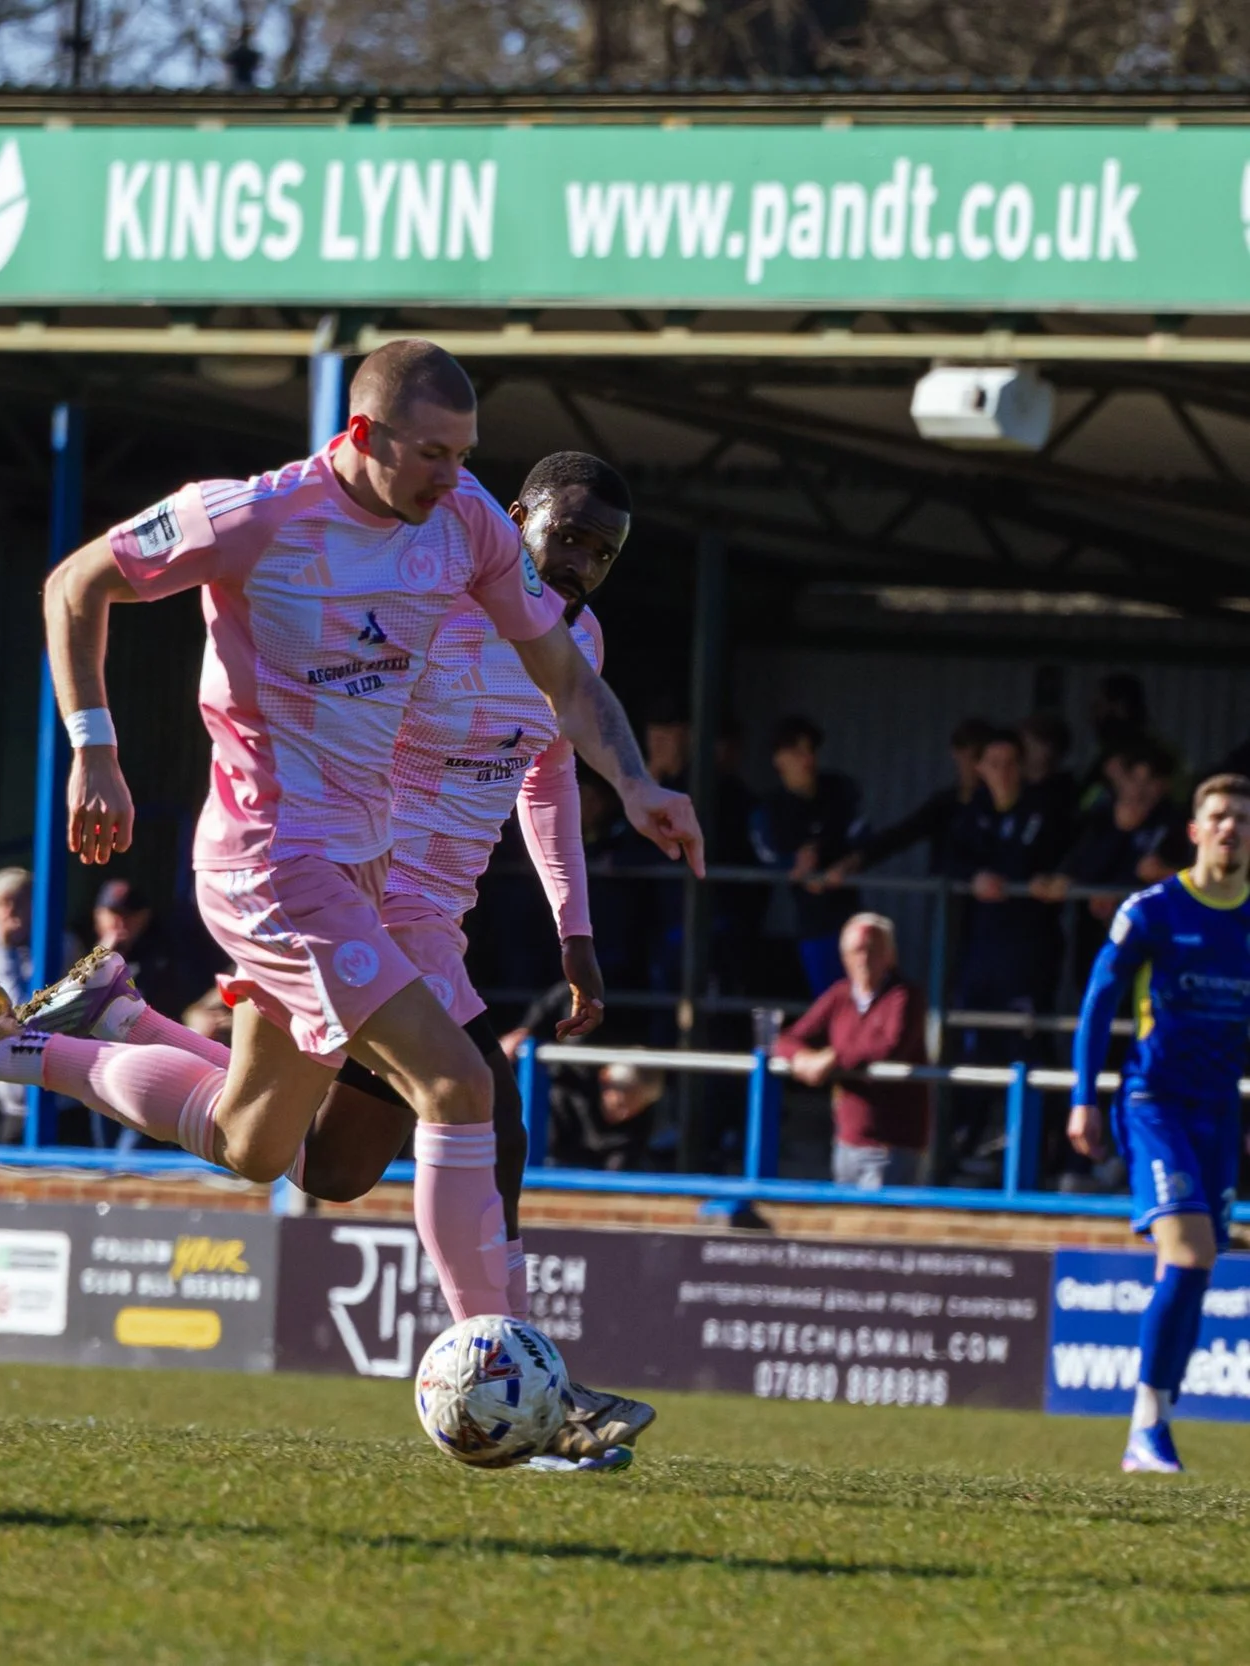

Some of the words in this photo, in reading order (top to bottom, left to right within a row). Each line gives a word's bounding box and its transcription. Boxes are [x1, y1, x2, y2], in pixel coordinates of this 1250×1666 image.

[103, 159, 306, 261] KINGS
[320, 159, 498, 261] LYNN
[565, 156, 1141, 285] www.pandt.co.uk
